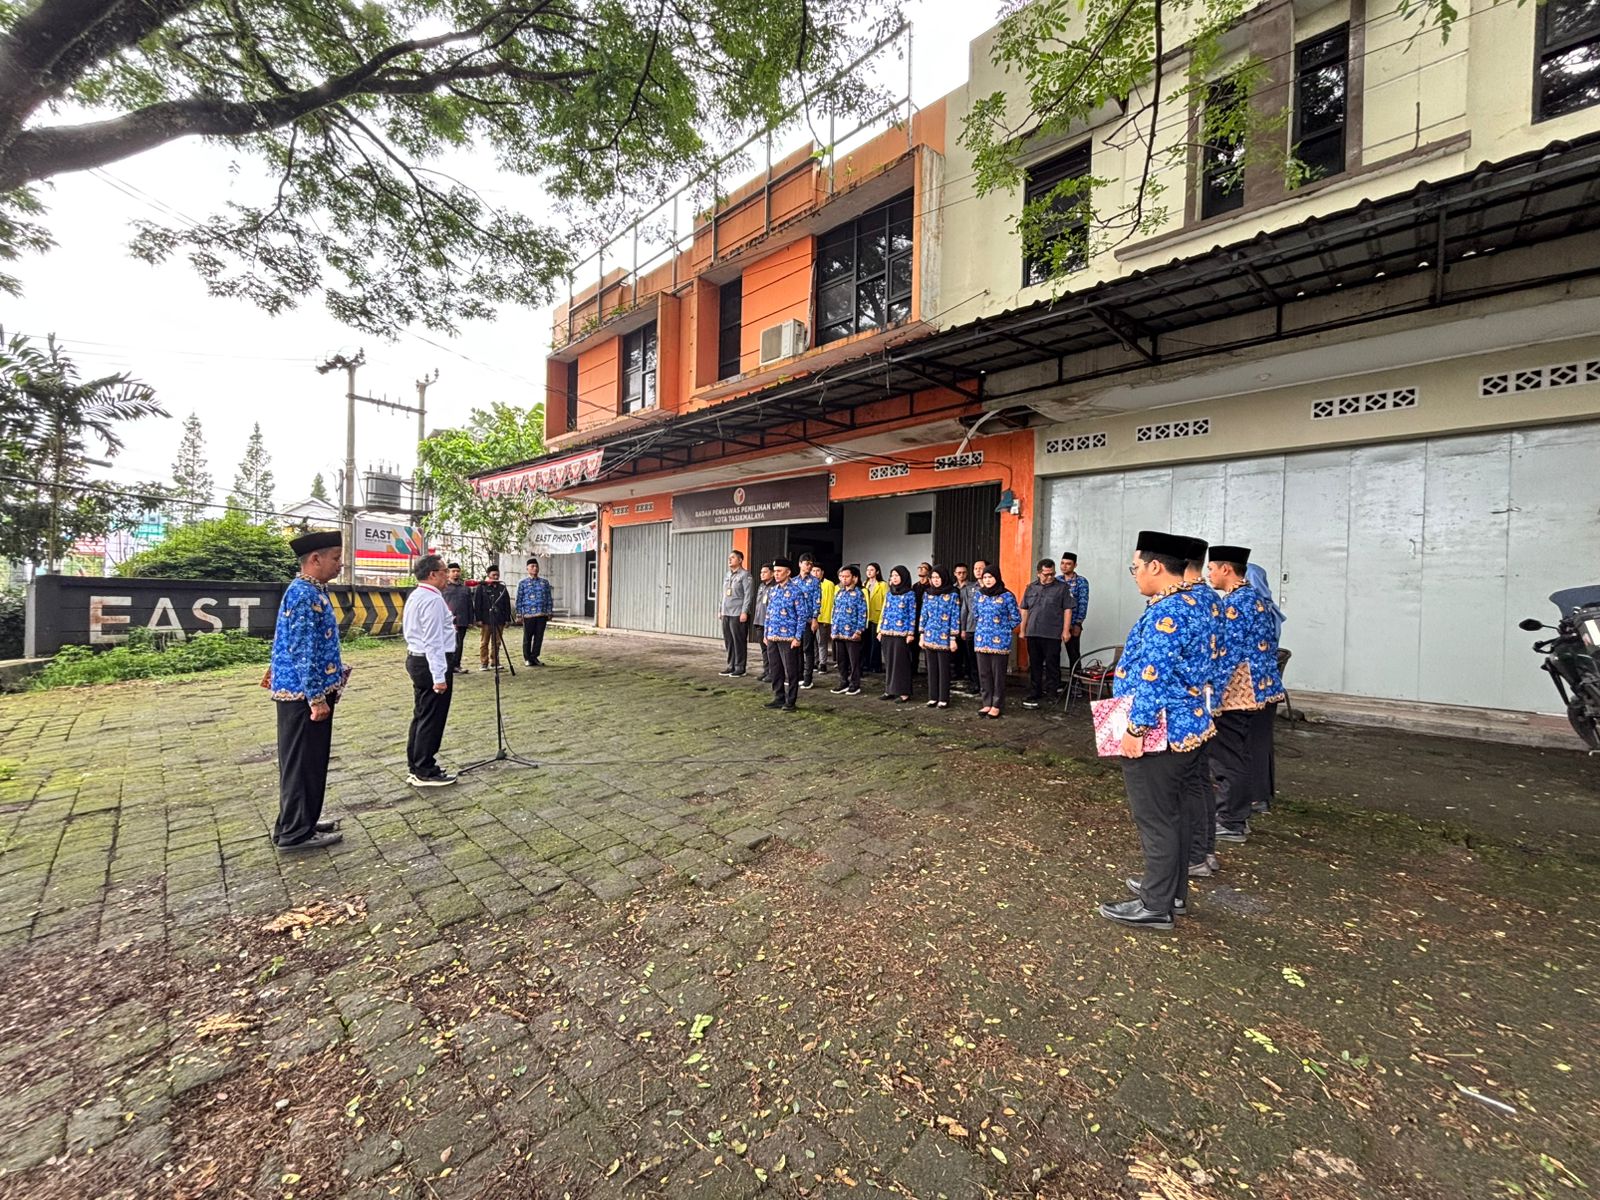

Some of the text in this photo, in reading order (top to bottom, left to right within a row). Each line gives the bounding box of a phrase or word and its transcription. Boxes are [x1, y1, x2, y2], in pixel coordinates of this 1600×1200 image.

[695, 501, 790, 518] BADAN PENGAWAS PEMILIHAN UMUM
[714, 512, 765, 523] KOTA TASIKMALAYA
[365, 528, 392, 540] EAST
[535, 534, 551, 543] EAST
[552, 533, 573, 543] PHOTO
[90, 595, 261, 644] EAST
